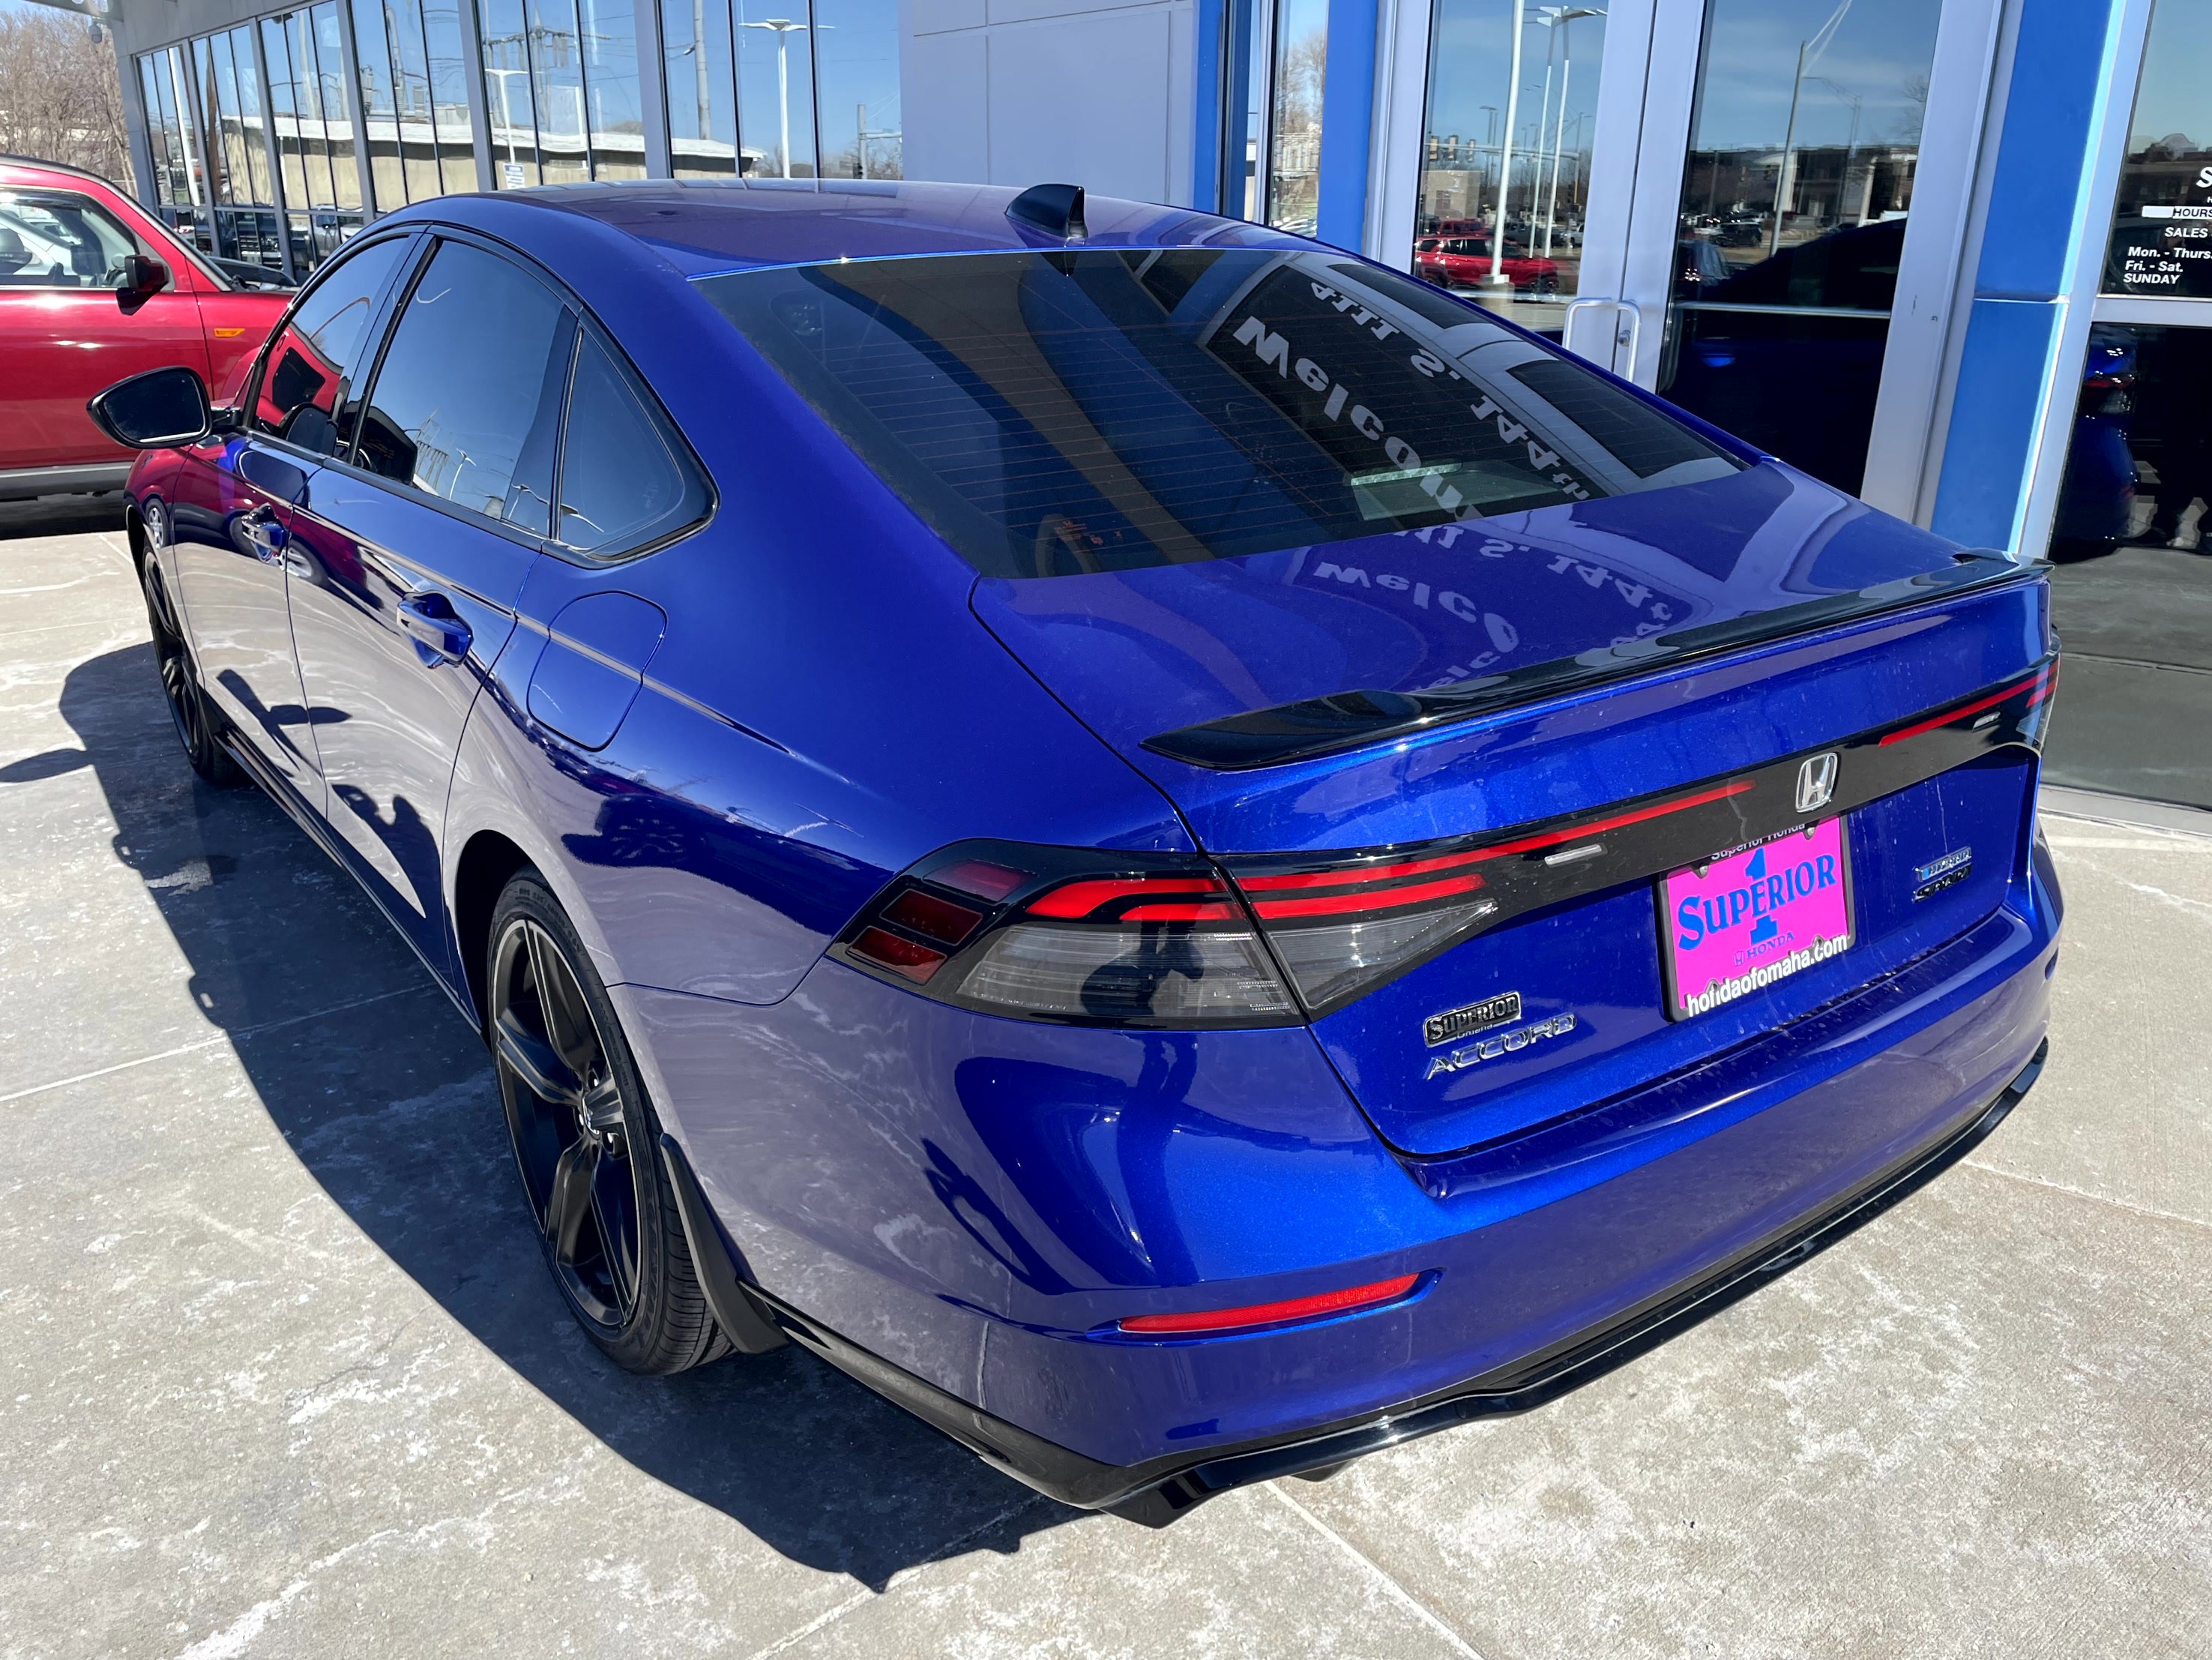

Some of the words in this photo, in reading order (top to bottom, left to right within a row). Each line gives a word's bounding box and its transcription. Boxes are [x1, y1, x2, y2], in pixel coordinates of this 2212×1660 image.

[2164, 227, 2209, 238] SALES
[2128, 247, 2161, 257] Mon.
[2125, 261, 2146, 271] Fri.
[2158, 262, 2184, 272] Sat.
[2123, 273, 2181, 284] SUNDAY
[1678, 854, 1836, 951] SUPERIOR
[1747, 931, 1795, 960] HONDA
[1429, 996, 1518, 1039] SUPERIOR
[1423, 1012, 1577, 1080] ACCORD
